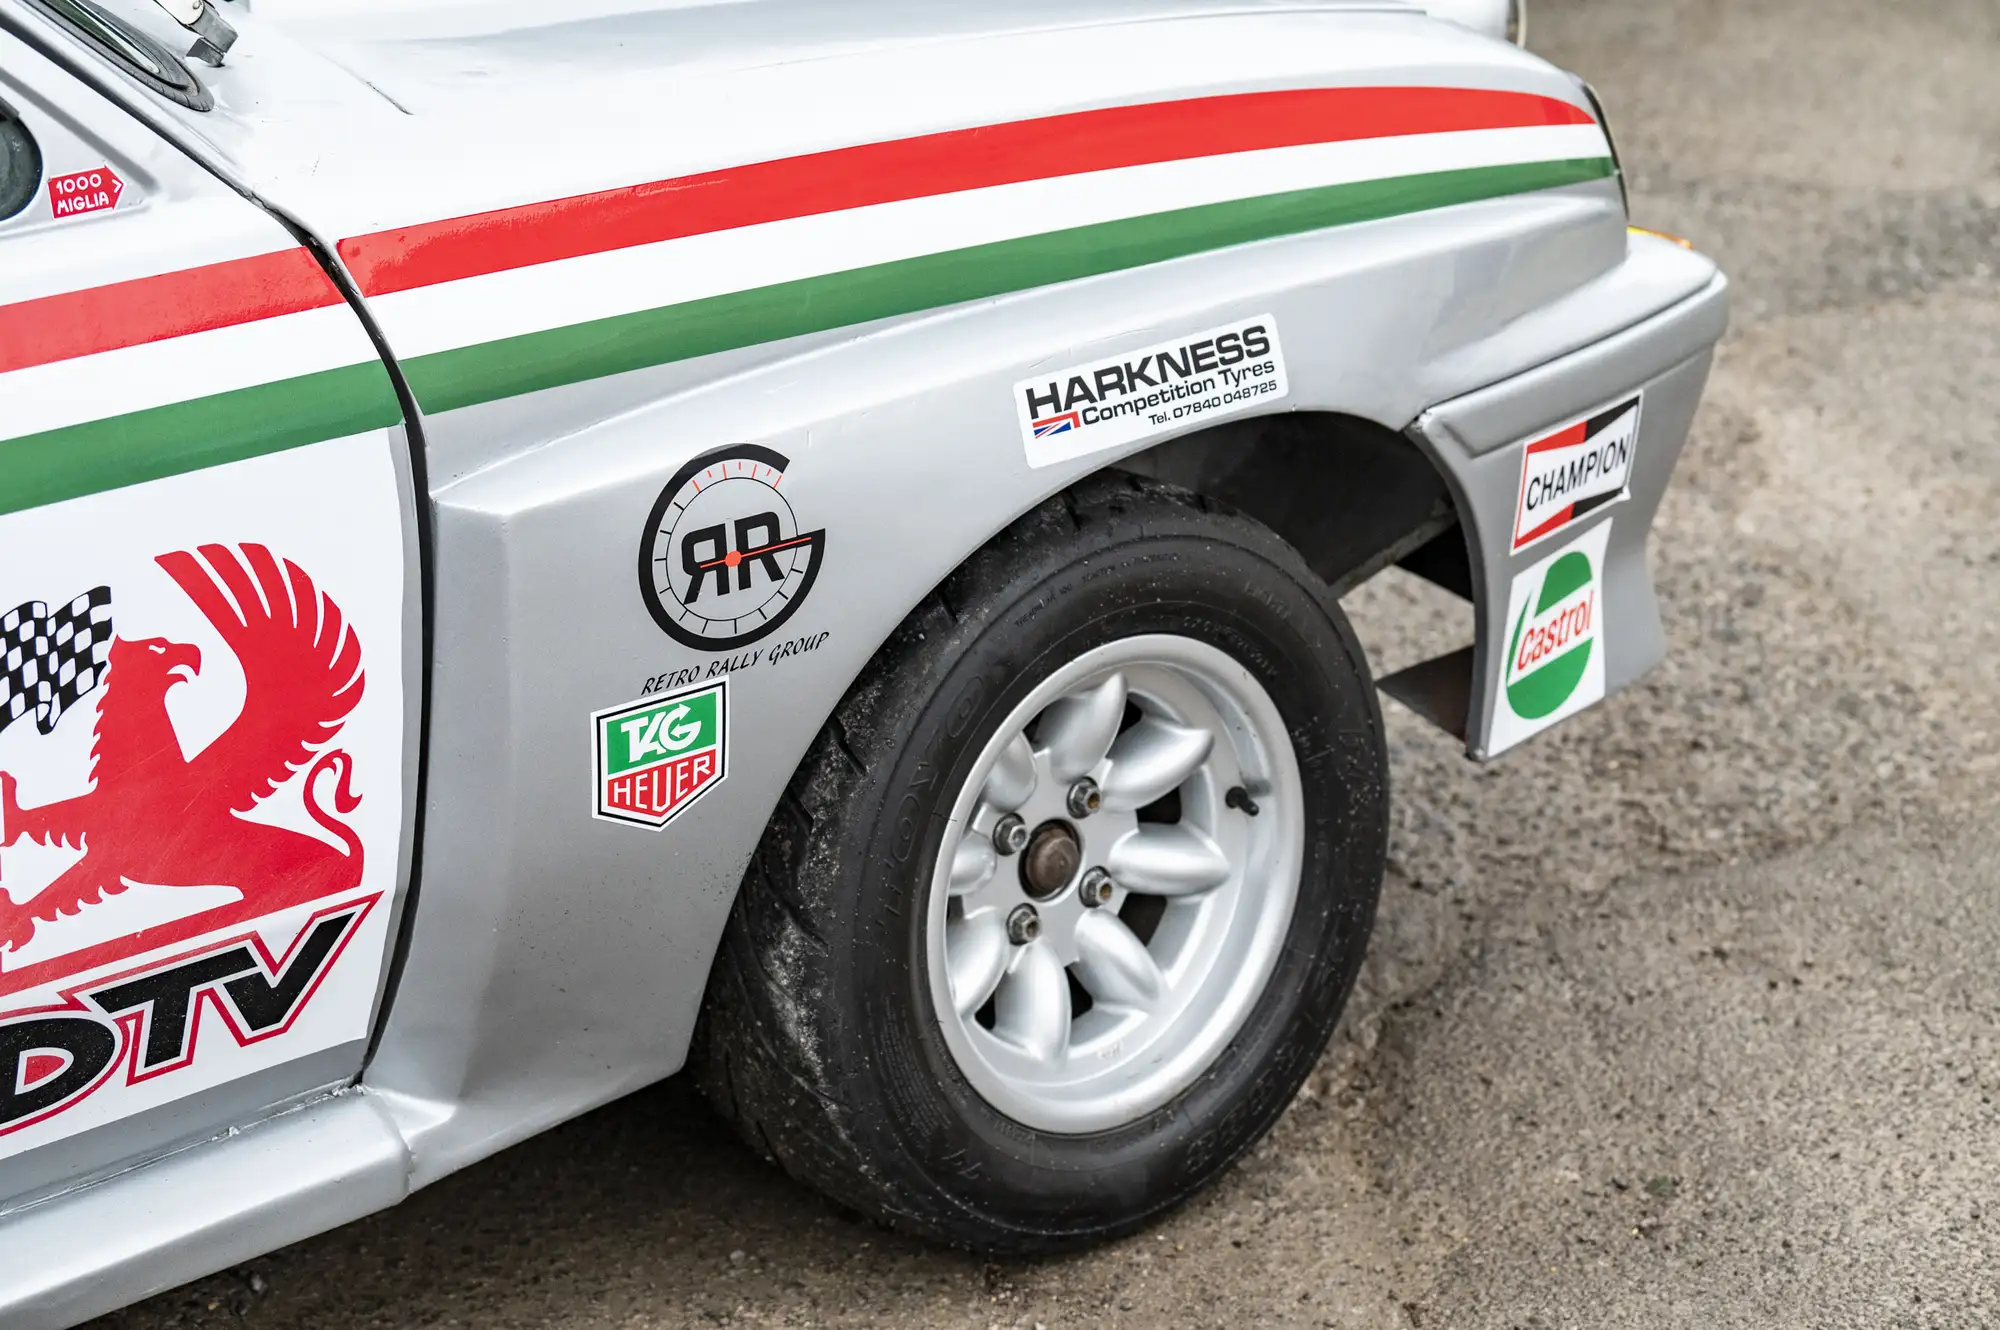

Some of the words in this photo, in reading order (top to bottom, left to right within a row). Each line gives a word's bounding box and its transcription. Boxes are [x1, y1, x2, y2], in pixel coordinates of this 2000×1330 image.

[56, 174, 102, 195] 1000
[57, 191, 110, 215] MIGLIA
[1025, 325, 1271, 420] HARKNESS
[1081, 376, 1216, 426] Competition
[1218, 360, 1275, 388] Tyres
[1148, 412, 1171, 426] Tel.
[1173, 397, 1222, 418] 07840
[1223, 379, 1278, 404] 048725
[1526, 433, 1632, 512] CHAMPION
[1517, 589, 1595, 671] Castrol
[640, 665, 700, 695] RETRO
[705, 649, 764, 678] RALLY
[768, 631, 830, 666] GROUP
[620, 703, 702, 763] TAG
[613, 755, 712, 813] HEUER
